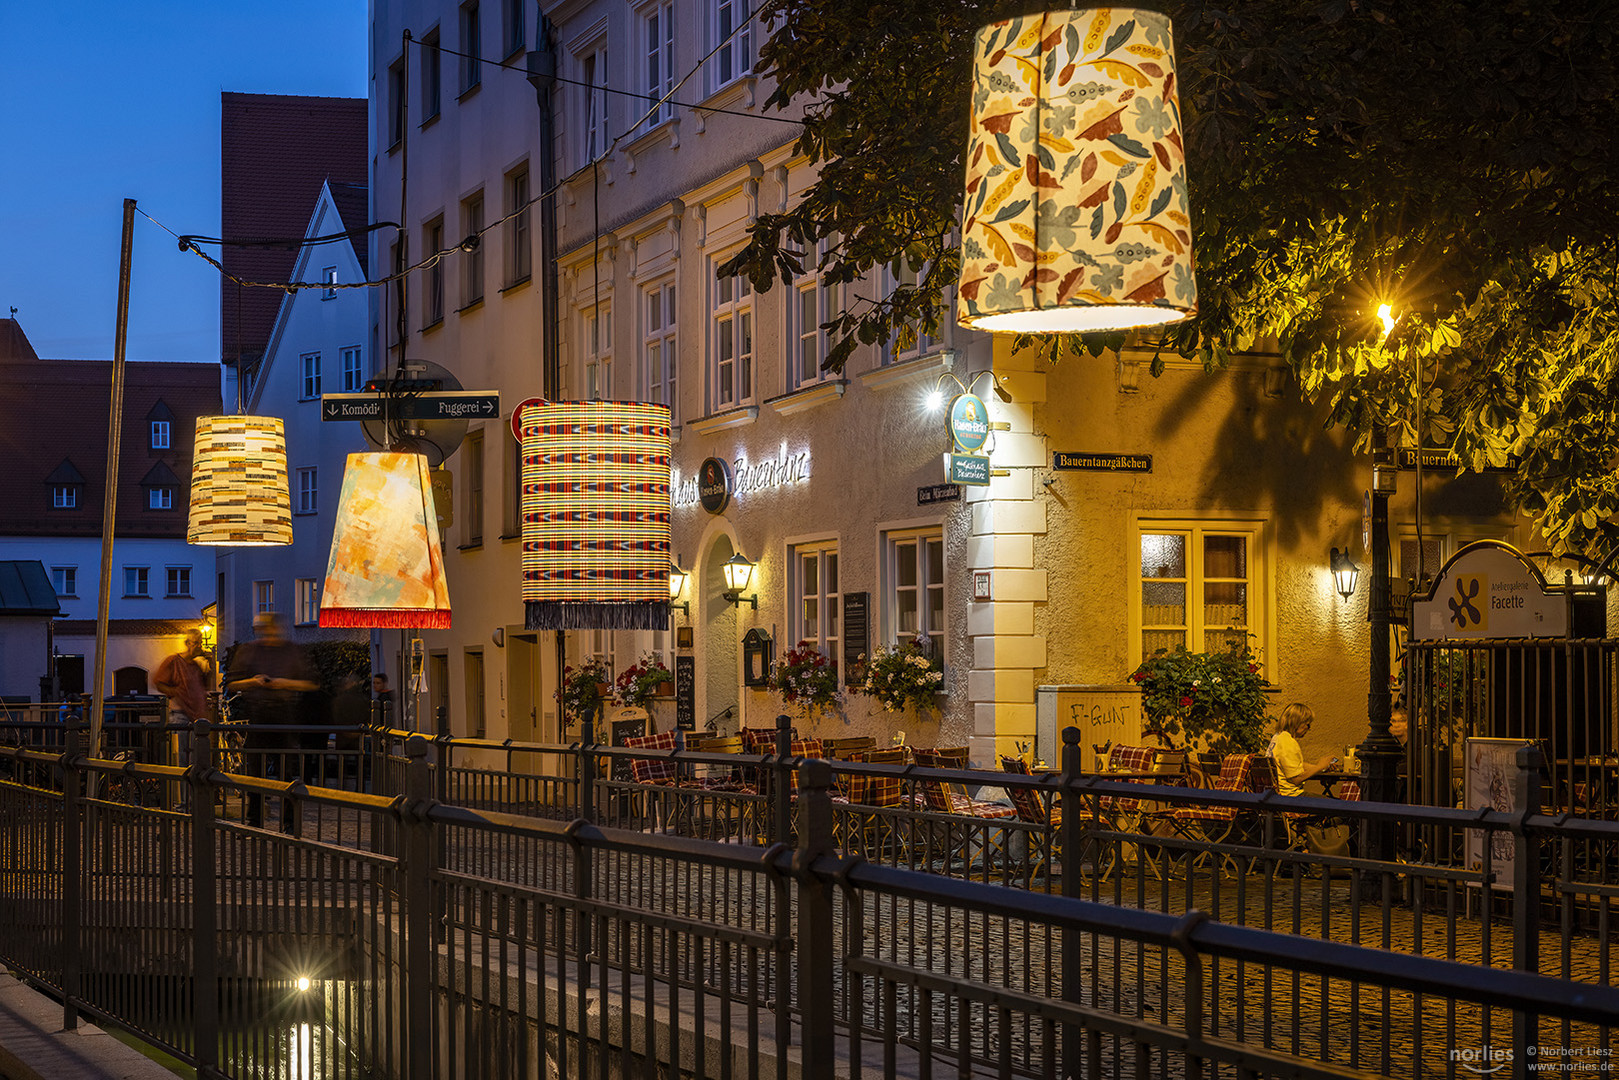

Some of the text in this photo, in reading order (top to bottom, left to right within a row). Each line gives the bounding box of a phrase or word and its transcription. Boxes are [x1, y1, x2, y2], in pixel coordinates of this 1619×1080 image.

[438, 401, 480, 416] Fuggerei
[734, 443, 813, 492] Bauerntanz
[1060, 454, 1147, 471] Bauerntanzgäßchen
[1491, 595, 1525, 609] Facette
[1070, 703, 1130, 727] F-GUN
